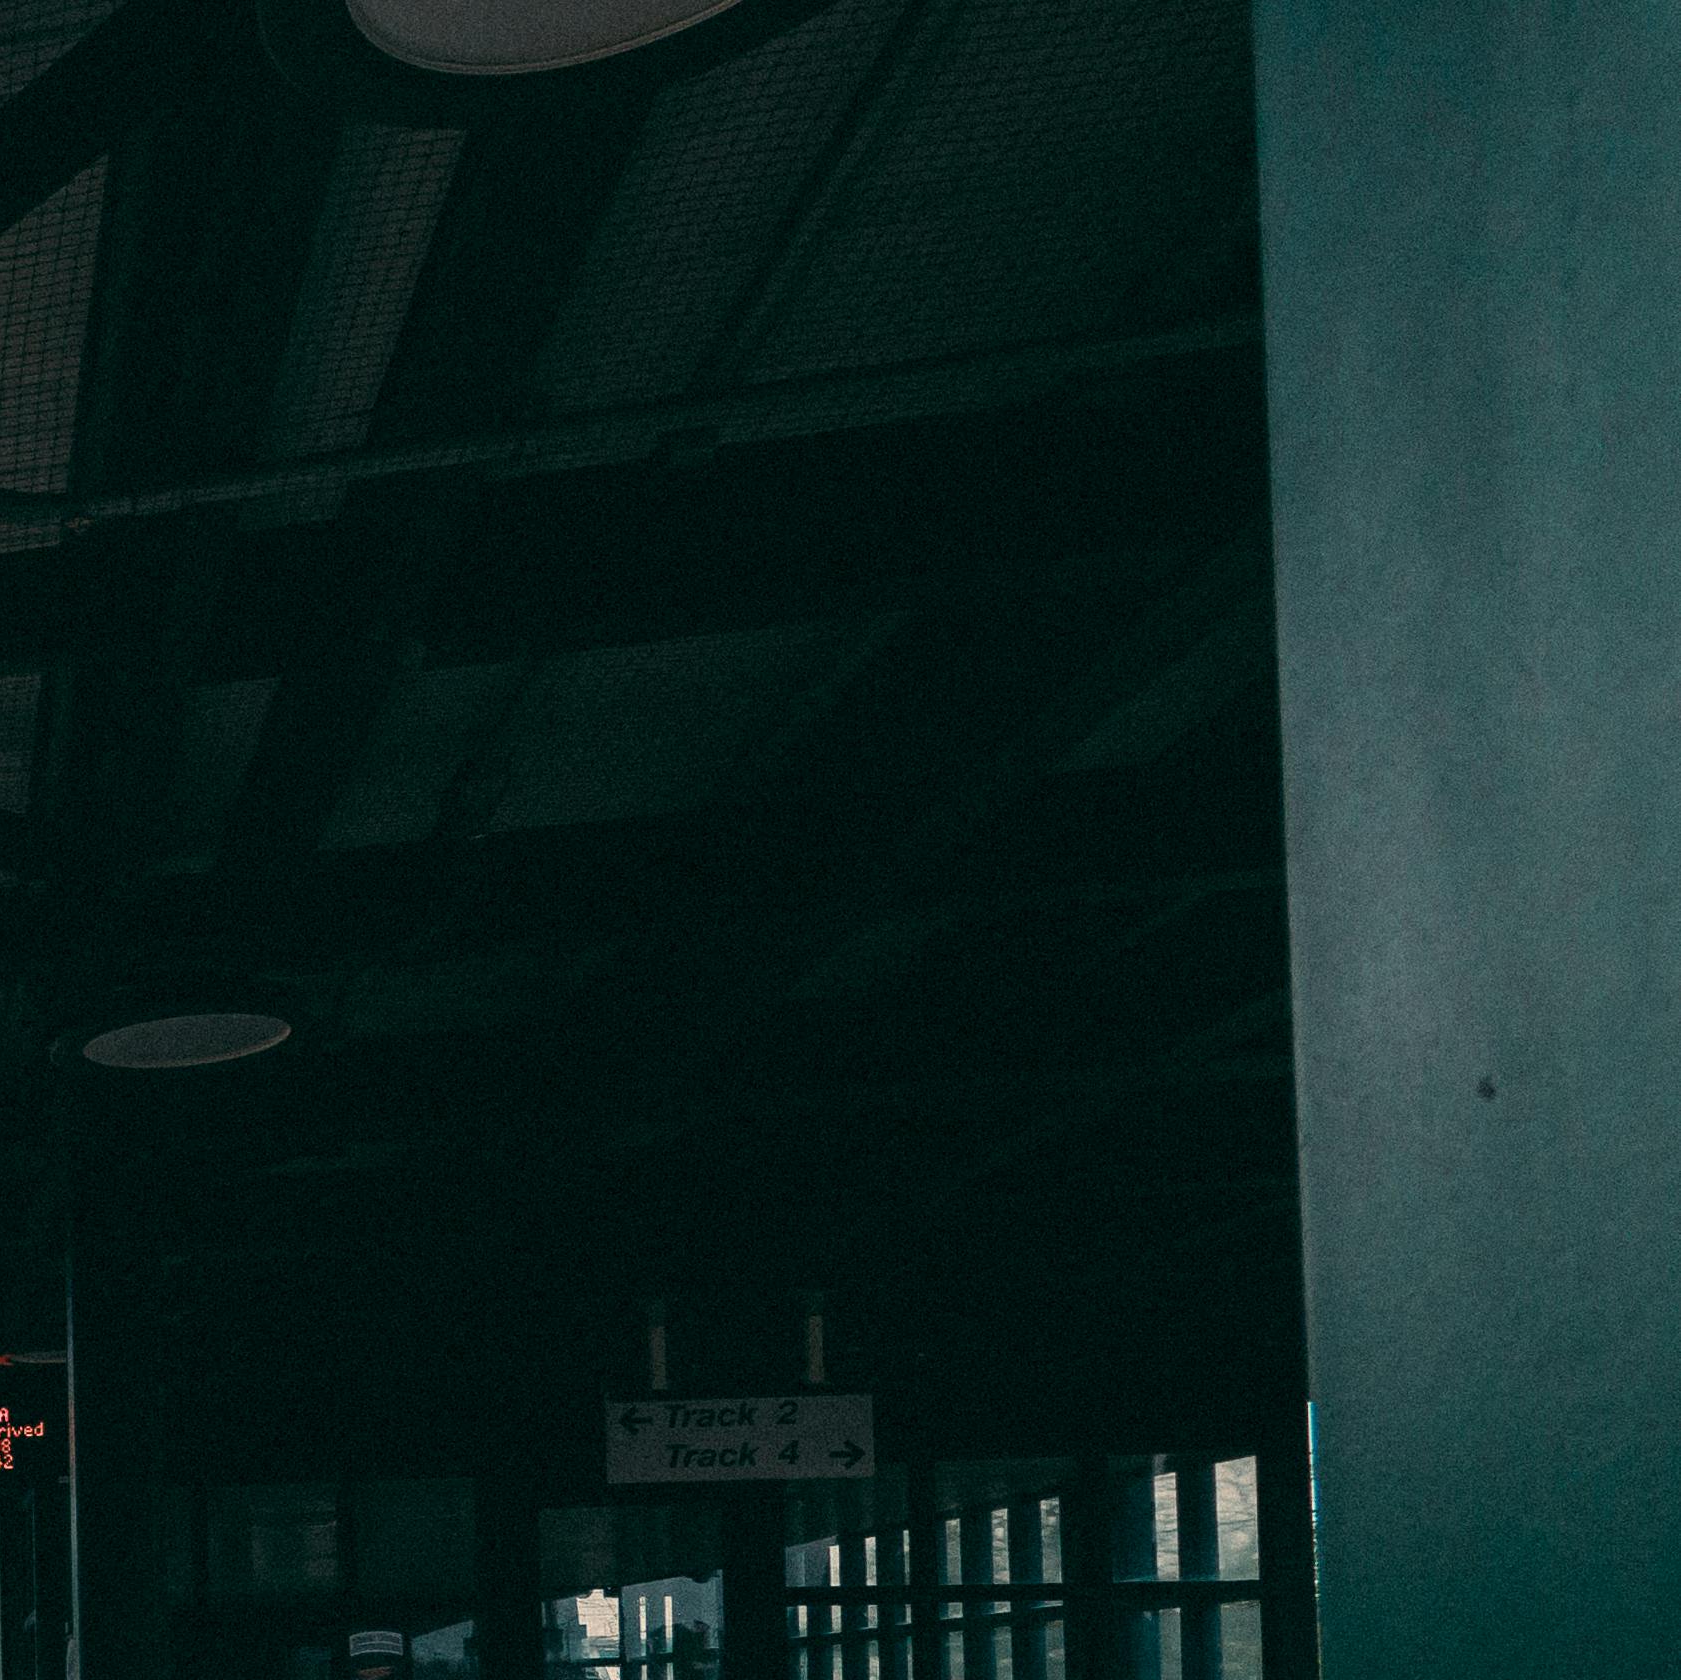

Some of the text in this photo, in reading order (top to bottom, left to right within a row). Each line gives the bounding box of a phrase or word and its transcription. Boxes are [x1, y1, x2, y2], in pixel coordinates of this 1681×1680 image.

[667, 1401, 799, 1428] Track 2
[666, 1440, 800, 1469] Track 4
